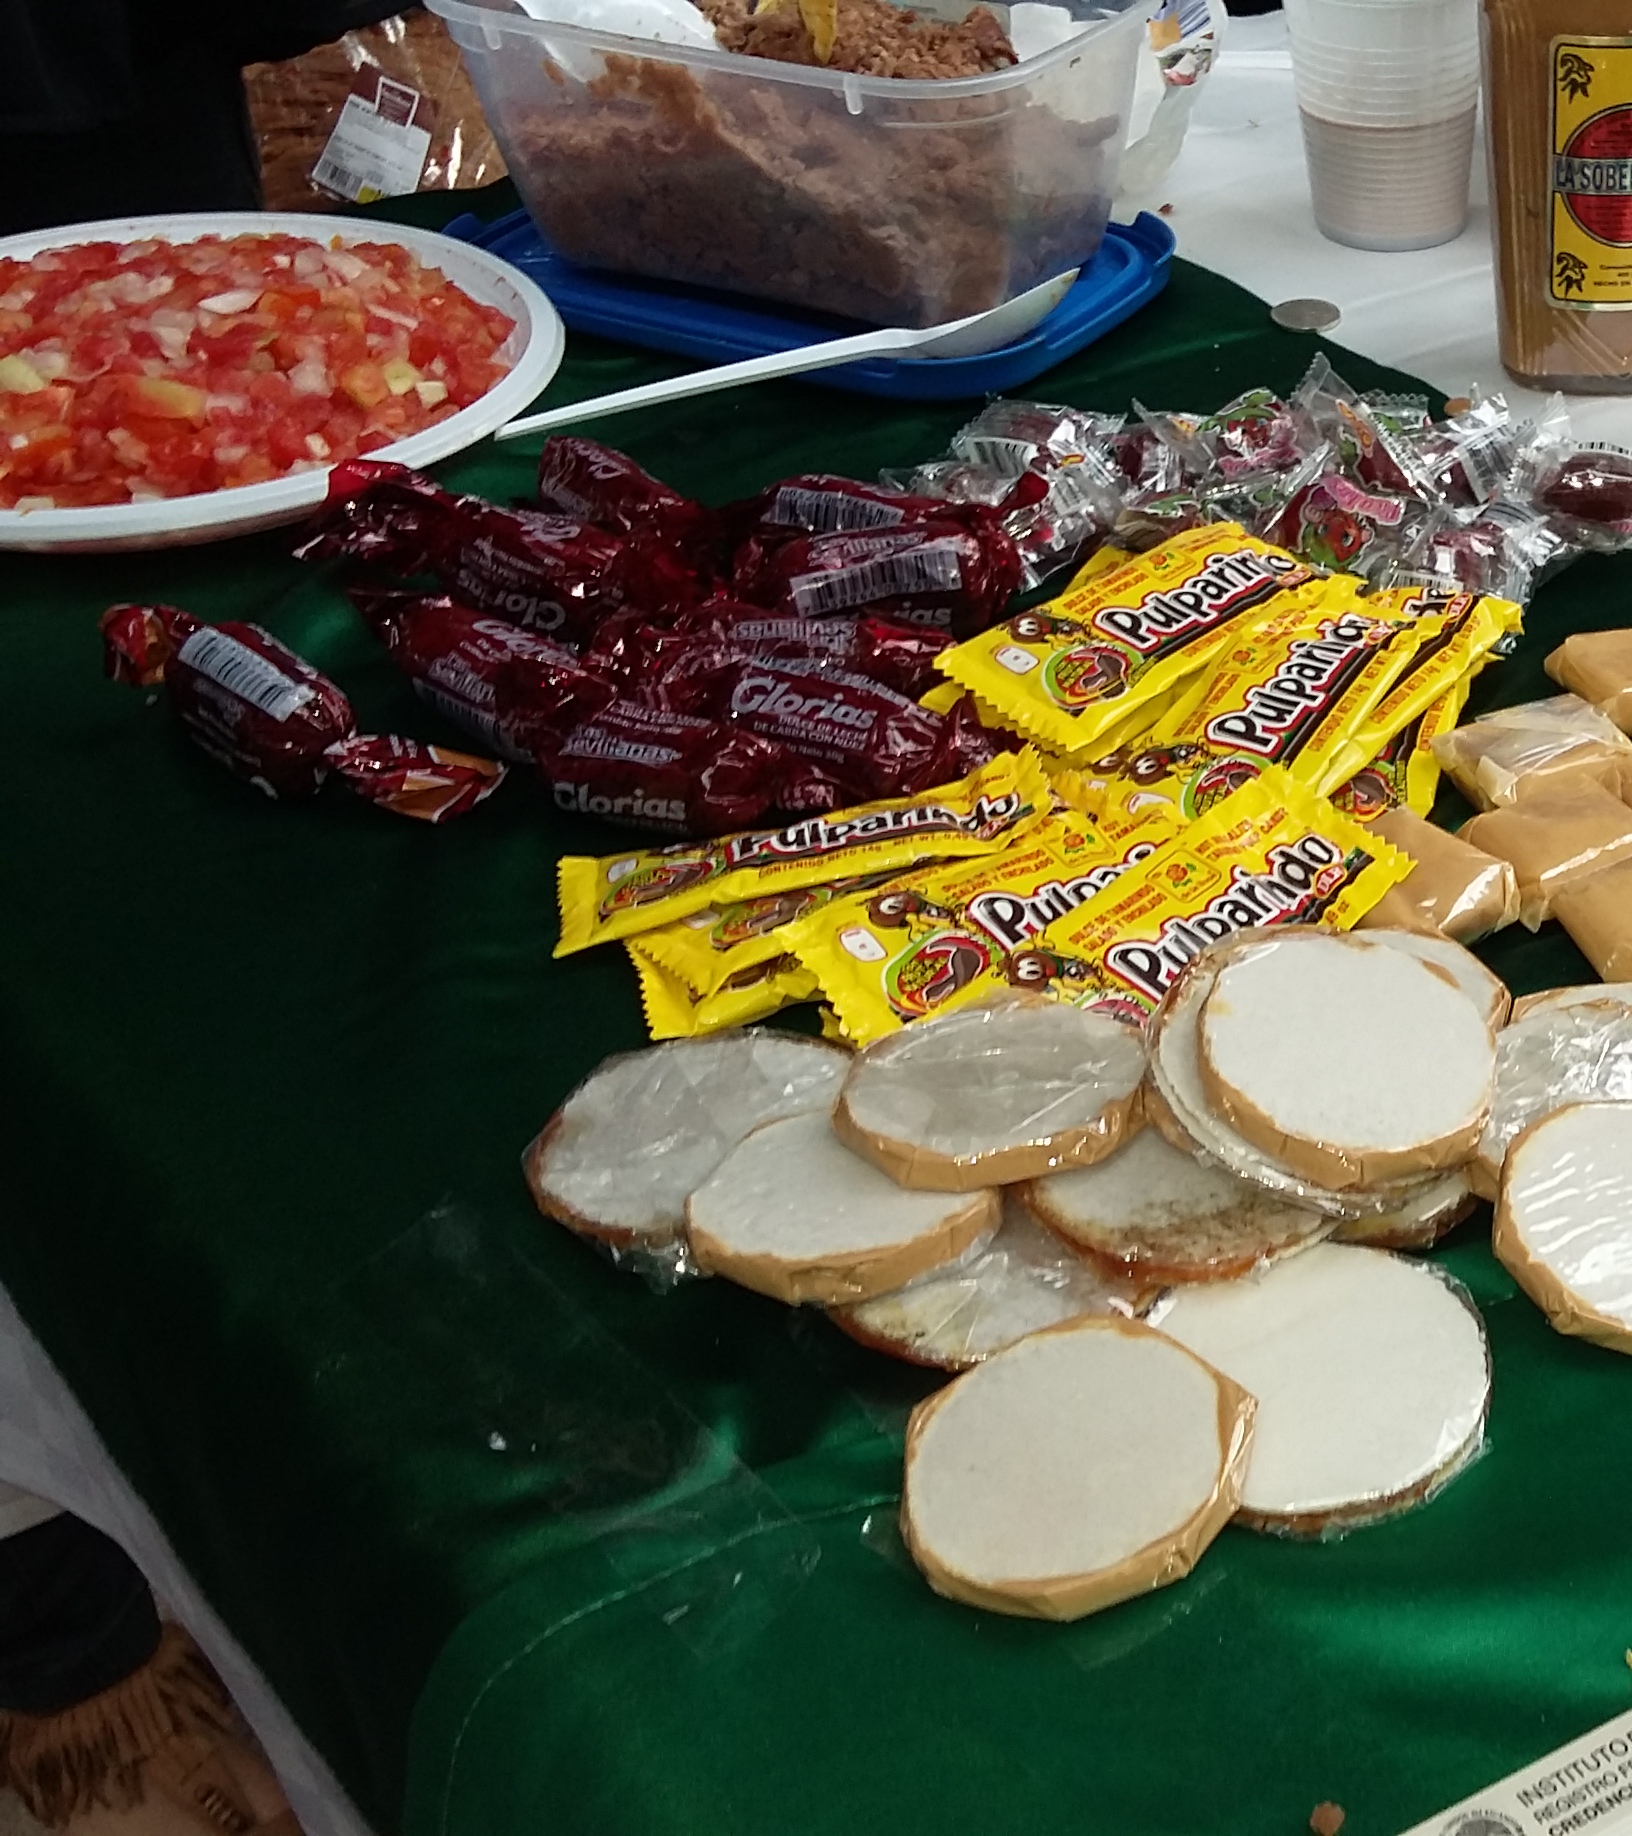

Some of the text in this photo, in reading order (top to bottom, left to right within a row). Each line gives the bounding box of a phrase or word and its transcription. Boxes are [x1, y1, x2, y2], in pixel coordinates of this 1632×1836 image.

[1555, 160, 1576, 191] LA
[1096, 549, 1298, 650] Pulparino
[731, 676, 878, 730] Glorias
[554, 781, 687, 821] Glorias
[1104, 831, 1344, 1001] Pulparindo
[1515, 1736, 1629, 1808] INSTITUTO
[1533, 1770, 1619, 1826] REGISTRO
